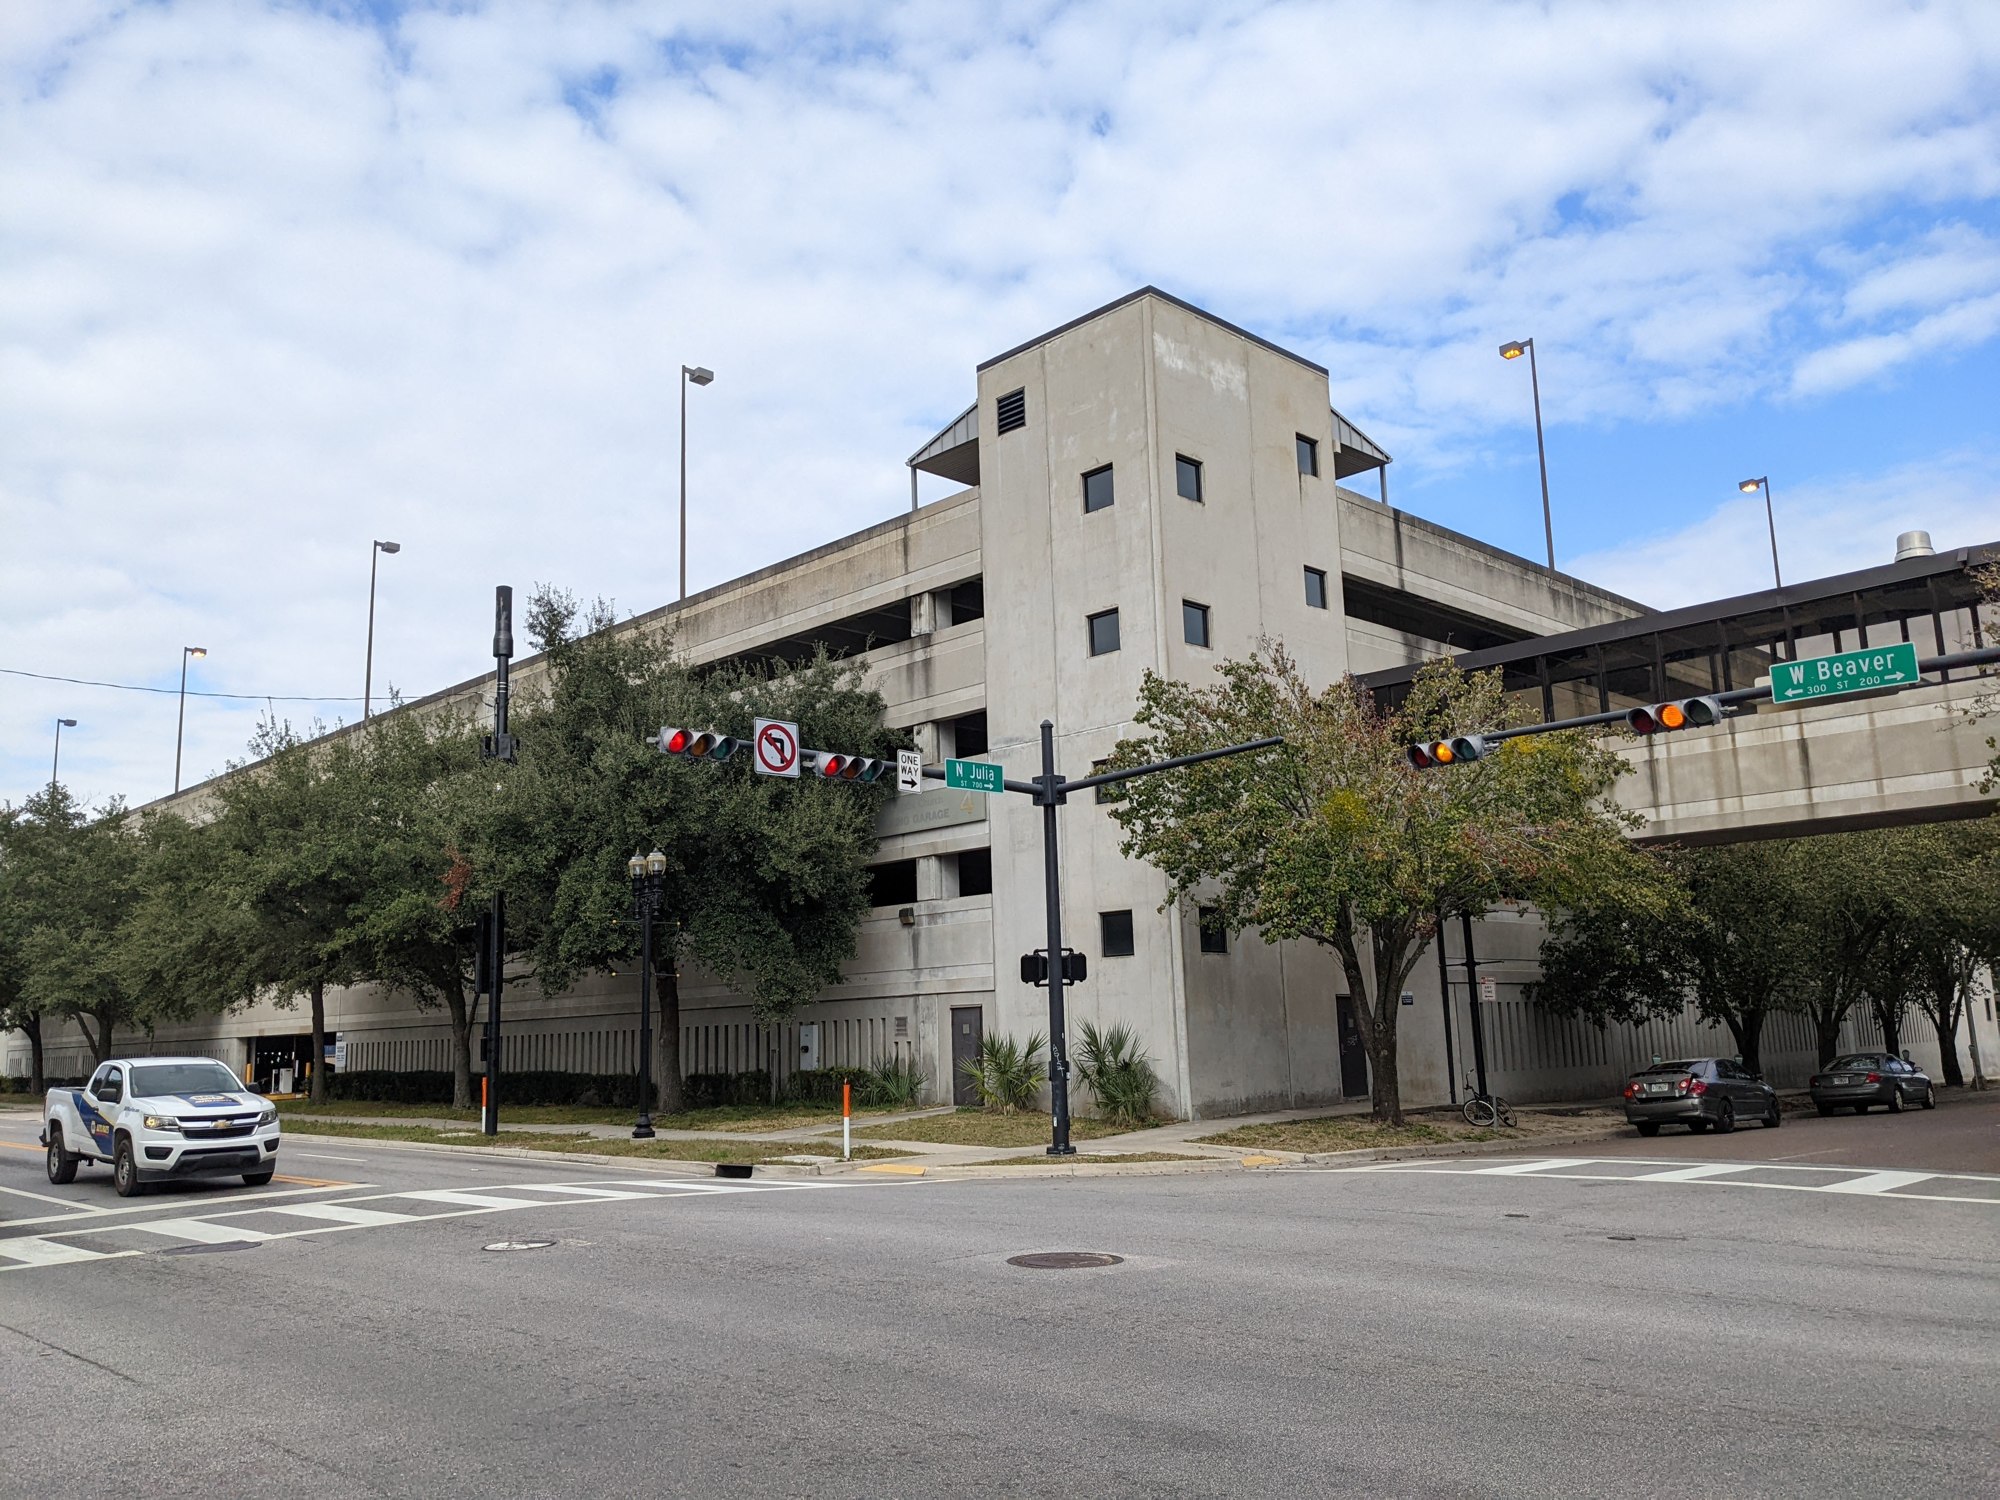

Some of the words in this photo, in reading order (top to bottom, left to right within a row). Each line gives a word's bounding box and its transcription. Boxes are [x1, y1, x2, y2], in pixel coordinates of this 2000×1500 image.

[1789, 664, 1804, 685] W
[1817, 653, 1895, 681] Beaver
[1807, 683, 1827, 695] 300
[1837, 680, 1849, 690] ST
[1859, 676, 1880, 686] 200
[901, 754, 919, 766] ONE
[901, 765, 919, 777] WAY
[955, 762, 963, 777] N
[969, 764, 995, 781] Julia
[972, 781, 983, 789] 700
